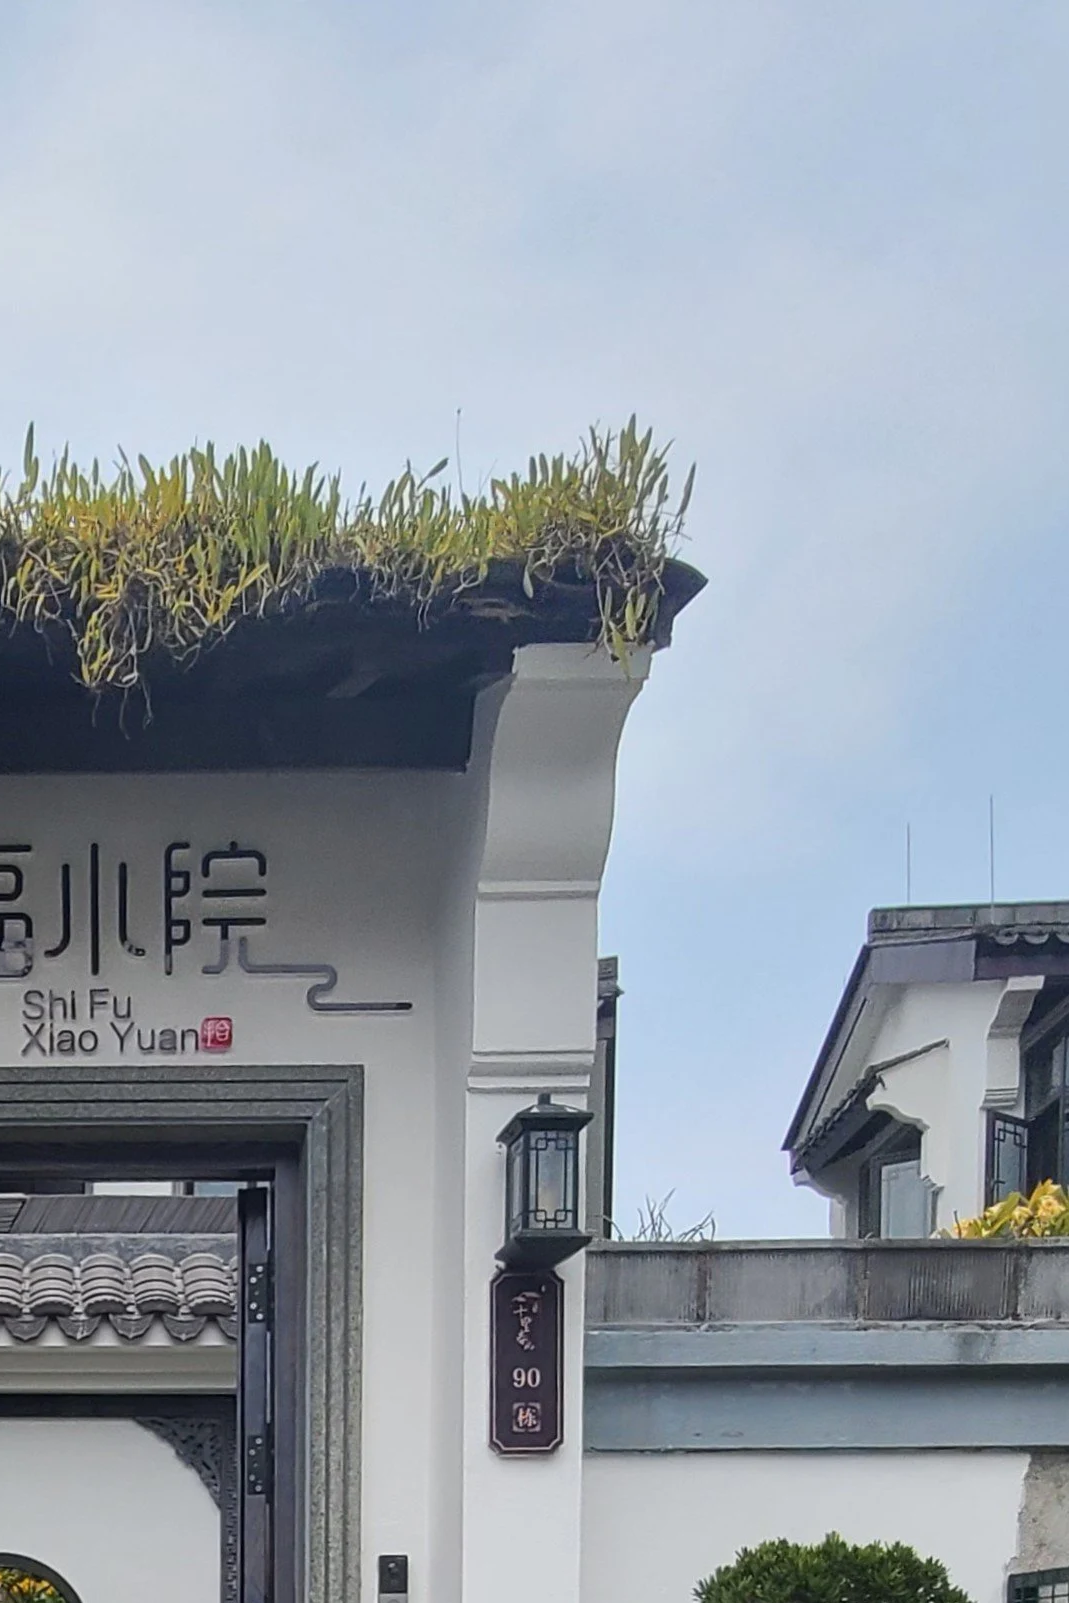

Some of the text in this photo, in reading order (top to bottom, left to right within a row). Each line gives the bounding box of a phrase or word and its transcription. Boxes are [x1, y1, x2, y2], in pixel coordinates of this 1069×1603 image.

[22, 988, 132, 1020] Shi Fu
[21, 1022, 199, 1055] Xiao Yuan
[512, 1367, 541, 1388] 90
